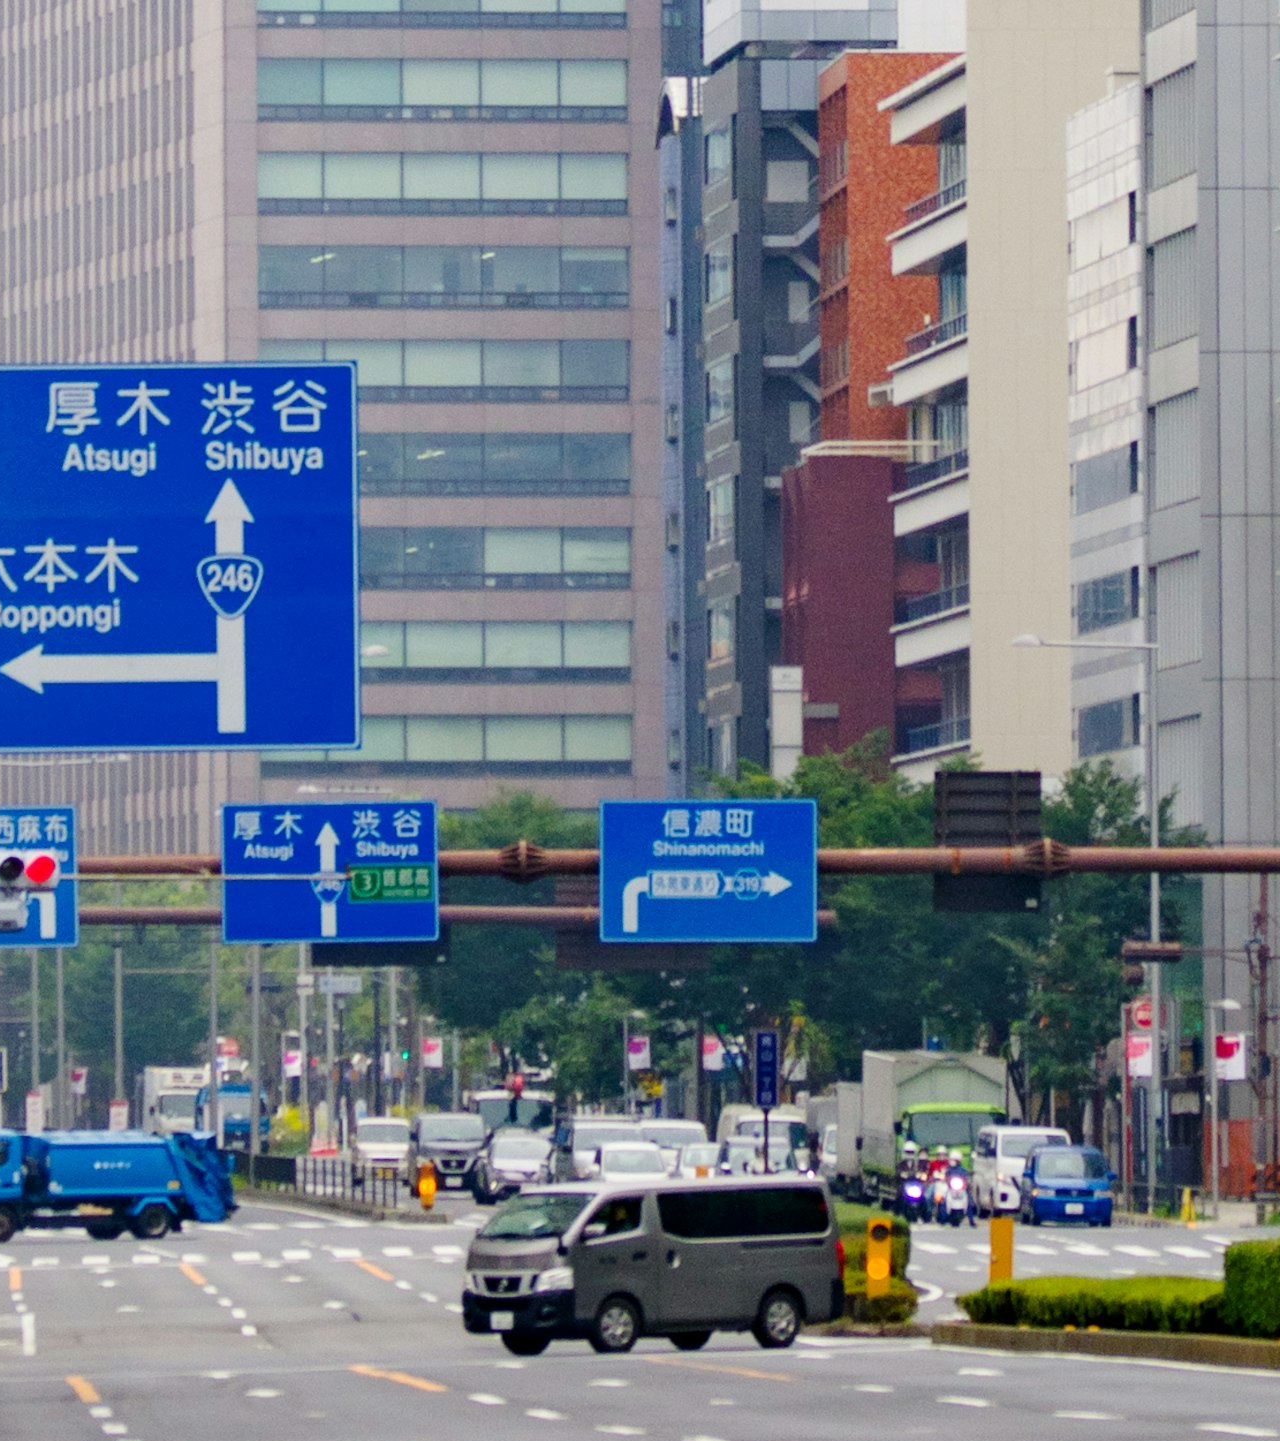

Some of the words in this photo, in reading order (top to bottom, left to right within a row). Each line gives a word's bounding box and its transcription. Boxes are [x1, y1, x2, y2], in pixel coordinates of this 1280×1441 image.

[46, 380, 170, 435] 厚木
[201, 380, 327, 434] 渋谷
[62, 443, 156, 477] Atsugi
[206, 441, 323, 475] Shibuya
[207, 564, 252, 592] 246
[233, 811, 303, 840] 厚木
[352, 809, 422, 838] 渋谷
[662, 809, 755, 838] 信濃町
[244, 843, 294, 862] Atsugi
[356, 841, 418, 859] Shibuya
[653, 840, 764, 857] Shinanomachi
